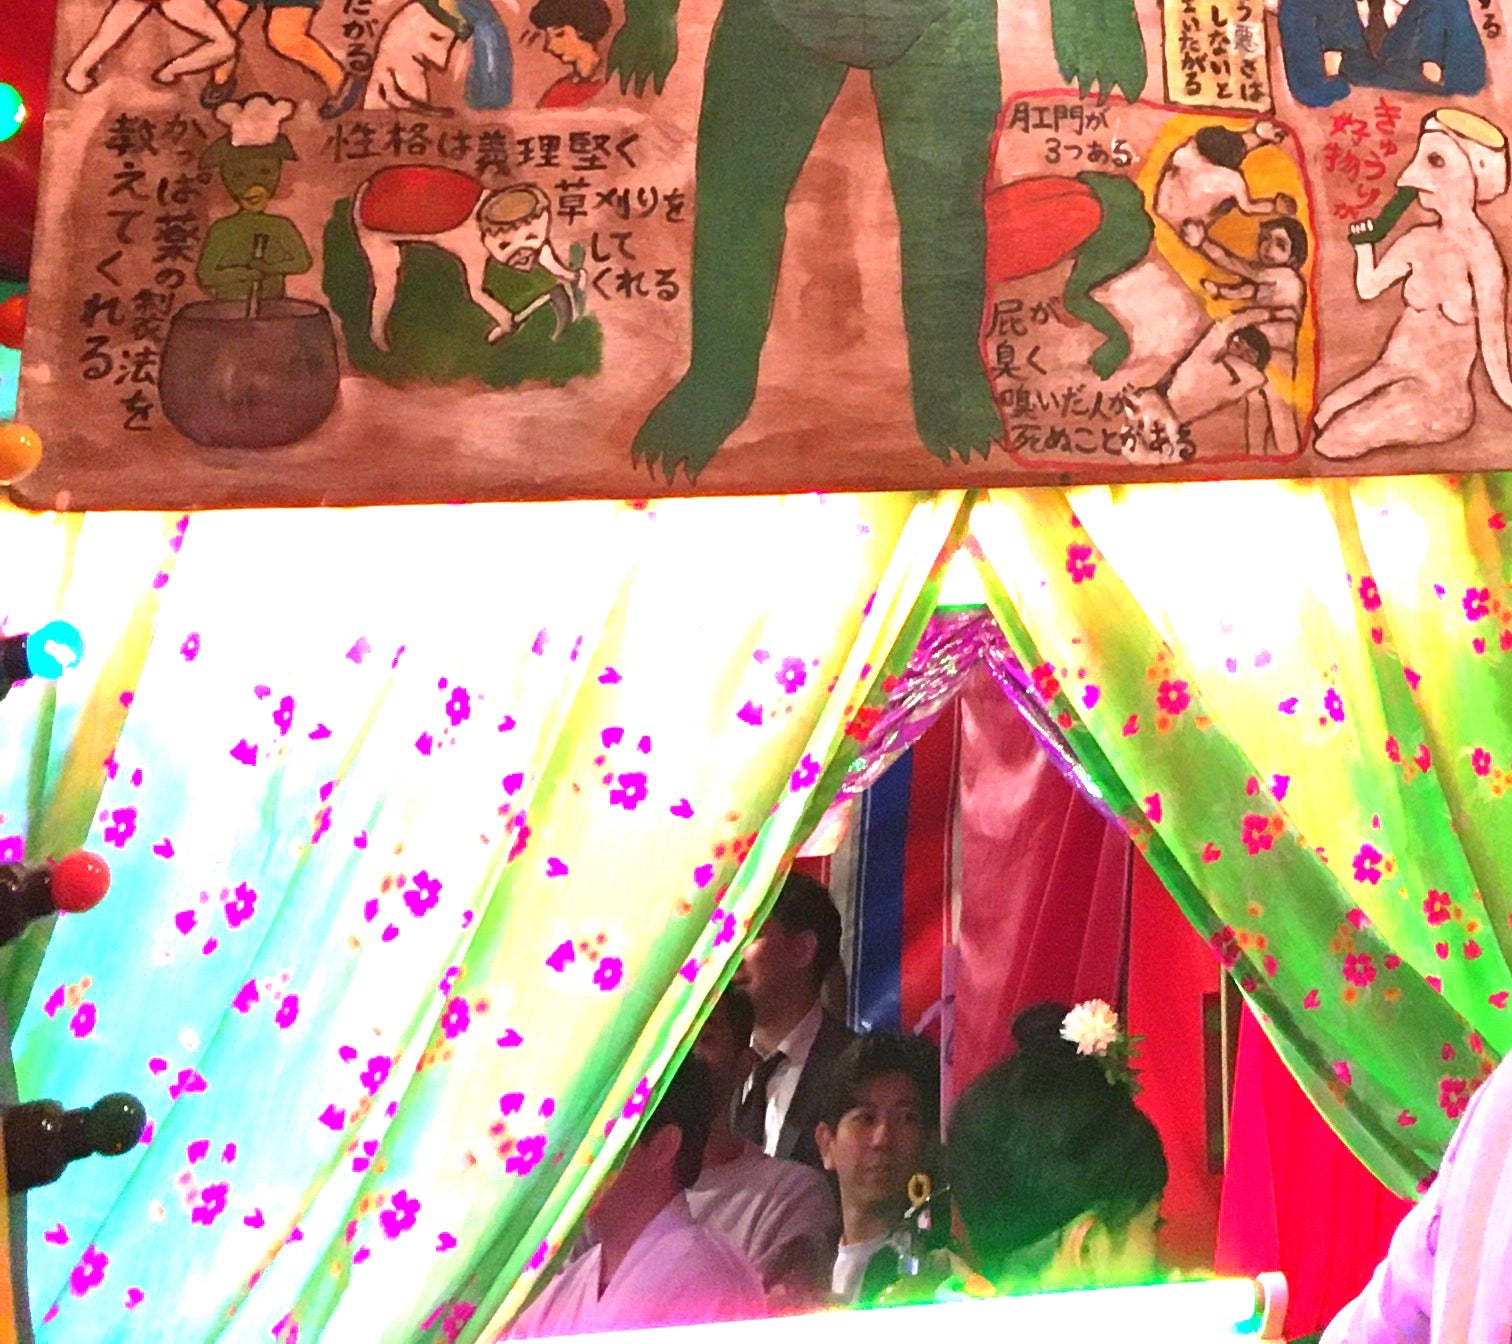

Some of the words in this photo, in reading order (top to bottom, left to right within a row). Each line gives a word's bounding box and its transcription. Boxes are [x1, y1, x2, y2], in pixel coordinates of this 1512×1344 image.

[1208, 5, 1234, 99] しないと
[80, 112, 158, 381] 教えてくれる
[554, 176, 686, 226] 草刈りを
